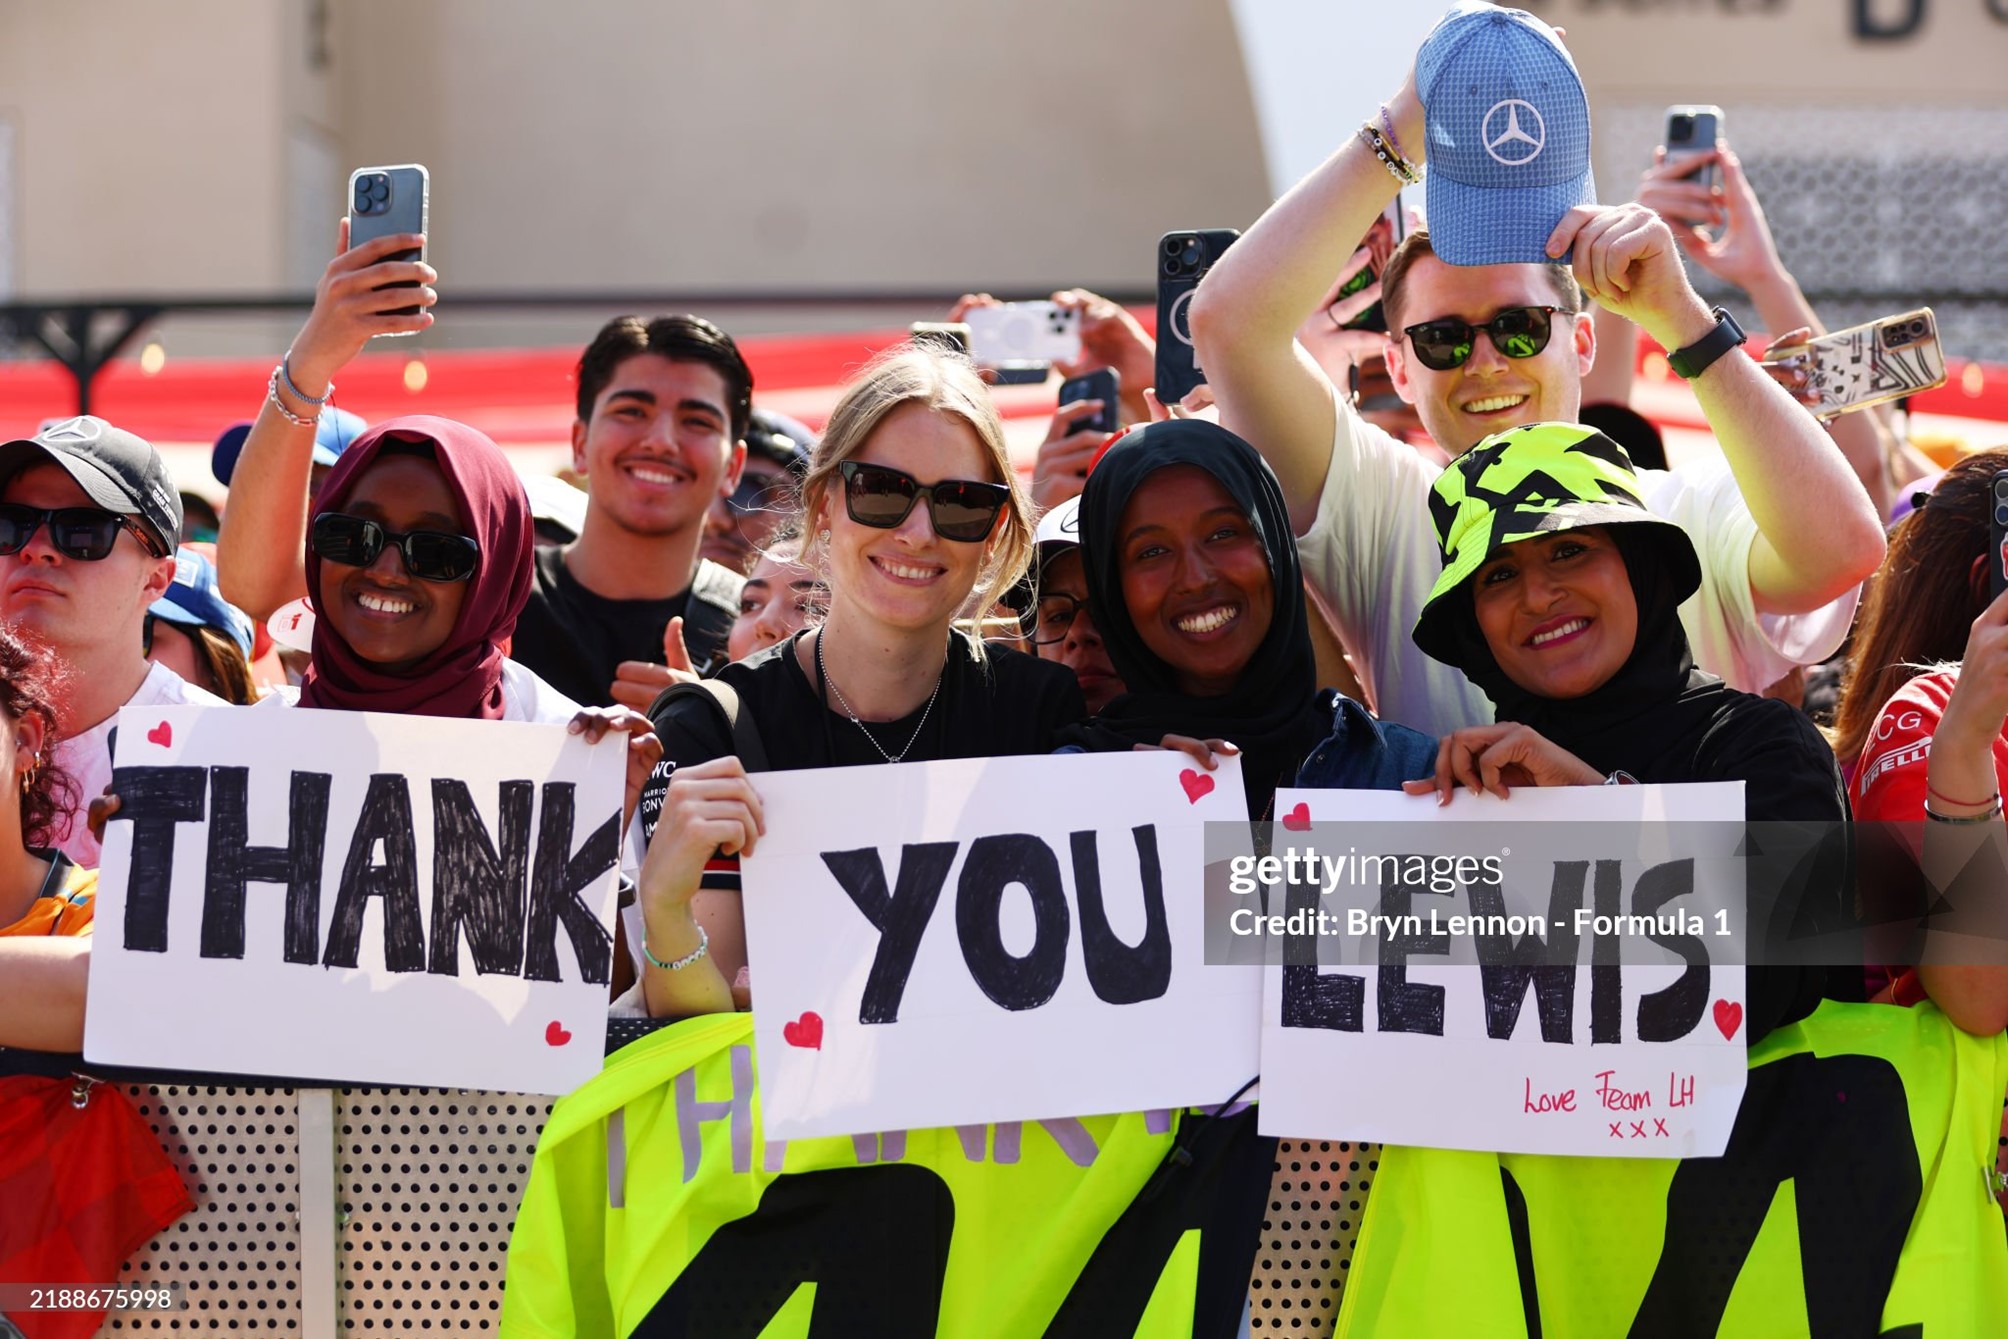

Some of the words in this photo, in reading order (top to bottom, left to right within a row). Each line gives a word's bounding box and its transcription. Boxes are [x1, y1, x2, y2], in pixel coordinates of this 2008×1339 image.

[107, 765, 624, 987] THANK
[819, 823, 1173, 1025] YOU
[1281, 853, 1711, 1046] LEWIS
[1524, 1077, 1577, 1114] Love
[1594, 1070, 1651, 1112] Team
[1669, 1071, 1695, 1108] LH
